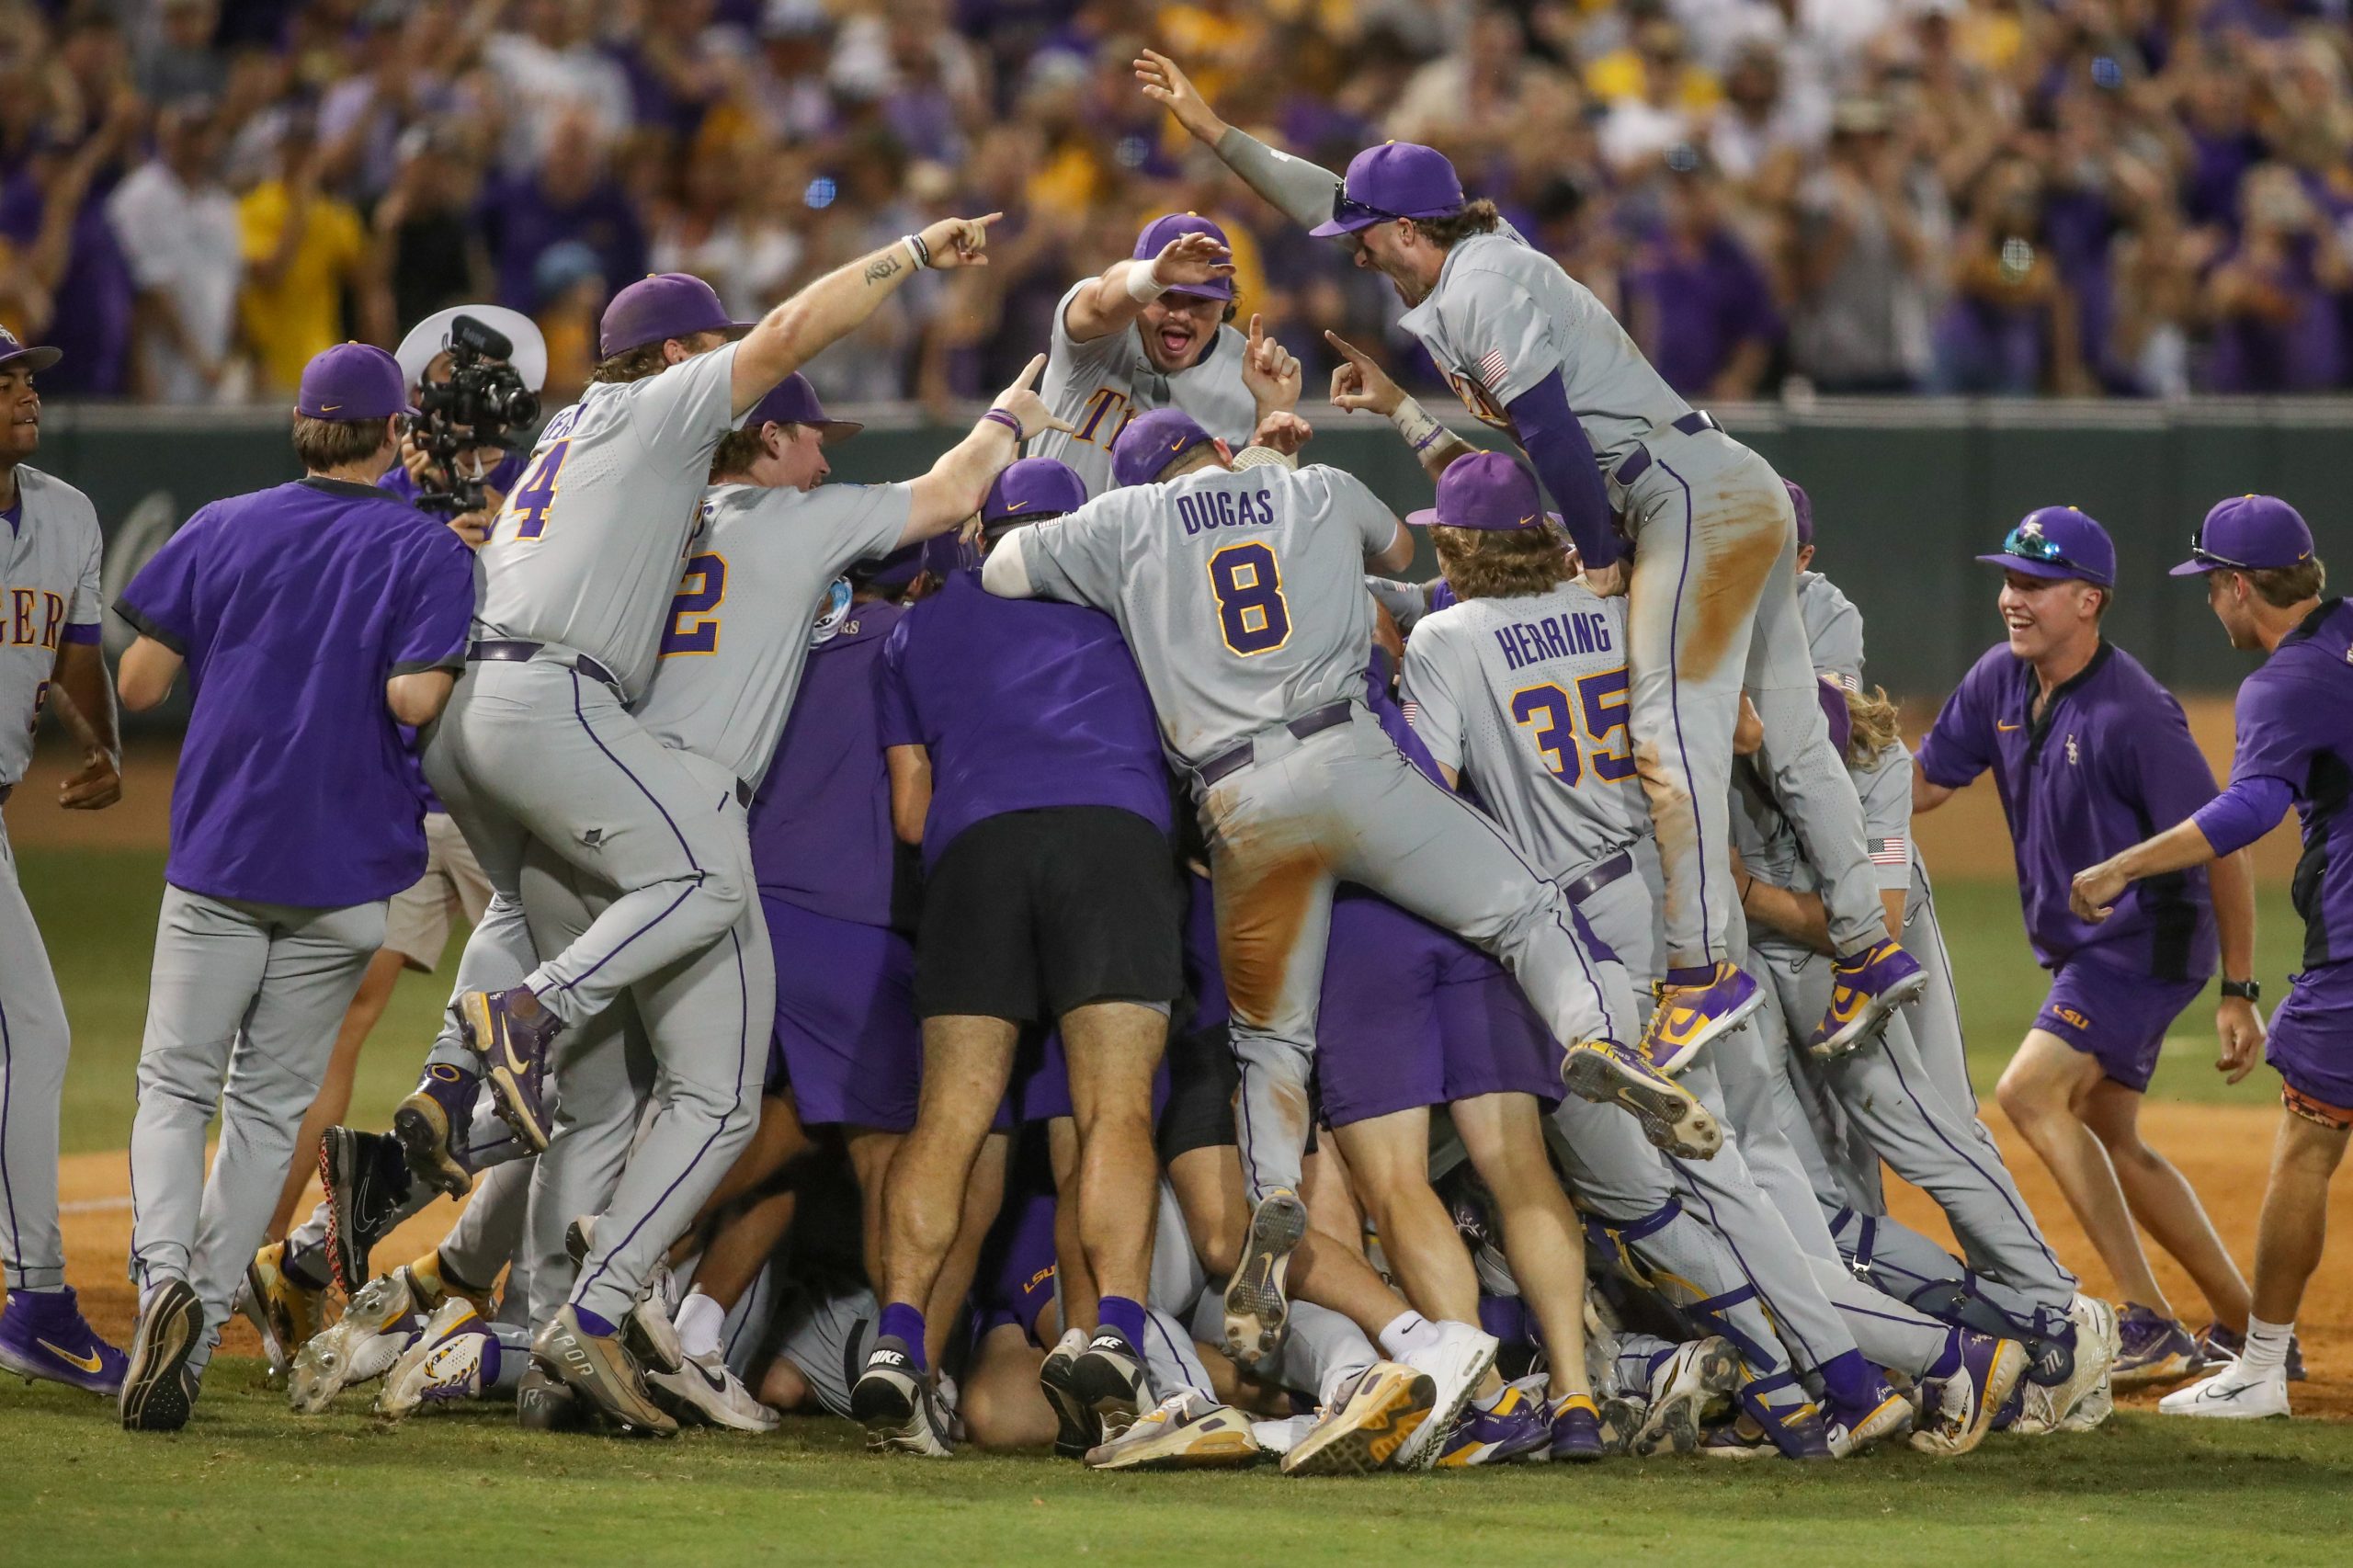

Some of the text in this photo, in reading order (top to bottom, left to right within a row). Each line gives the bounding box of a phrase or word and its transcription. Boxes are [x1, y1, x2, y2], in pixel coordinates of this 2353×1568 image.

[1176, 489, 1275, 536] DUGAS
[0, 587, 64, 652] ER
[658, 551, 729, 662] 2
[1206, 540, 1293, 658] 8
[1494, 612, 1612, 671] HERRING
[1508, 665, 1639, 790] 35
[2052, 1004, 2089, 1029] LSU
[1023, 1265, 1056, 1294] LSU
[866, 1349, 904, 1369] NIKE
[1088, 1335, 1123, 1349] NIKE
